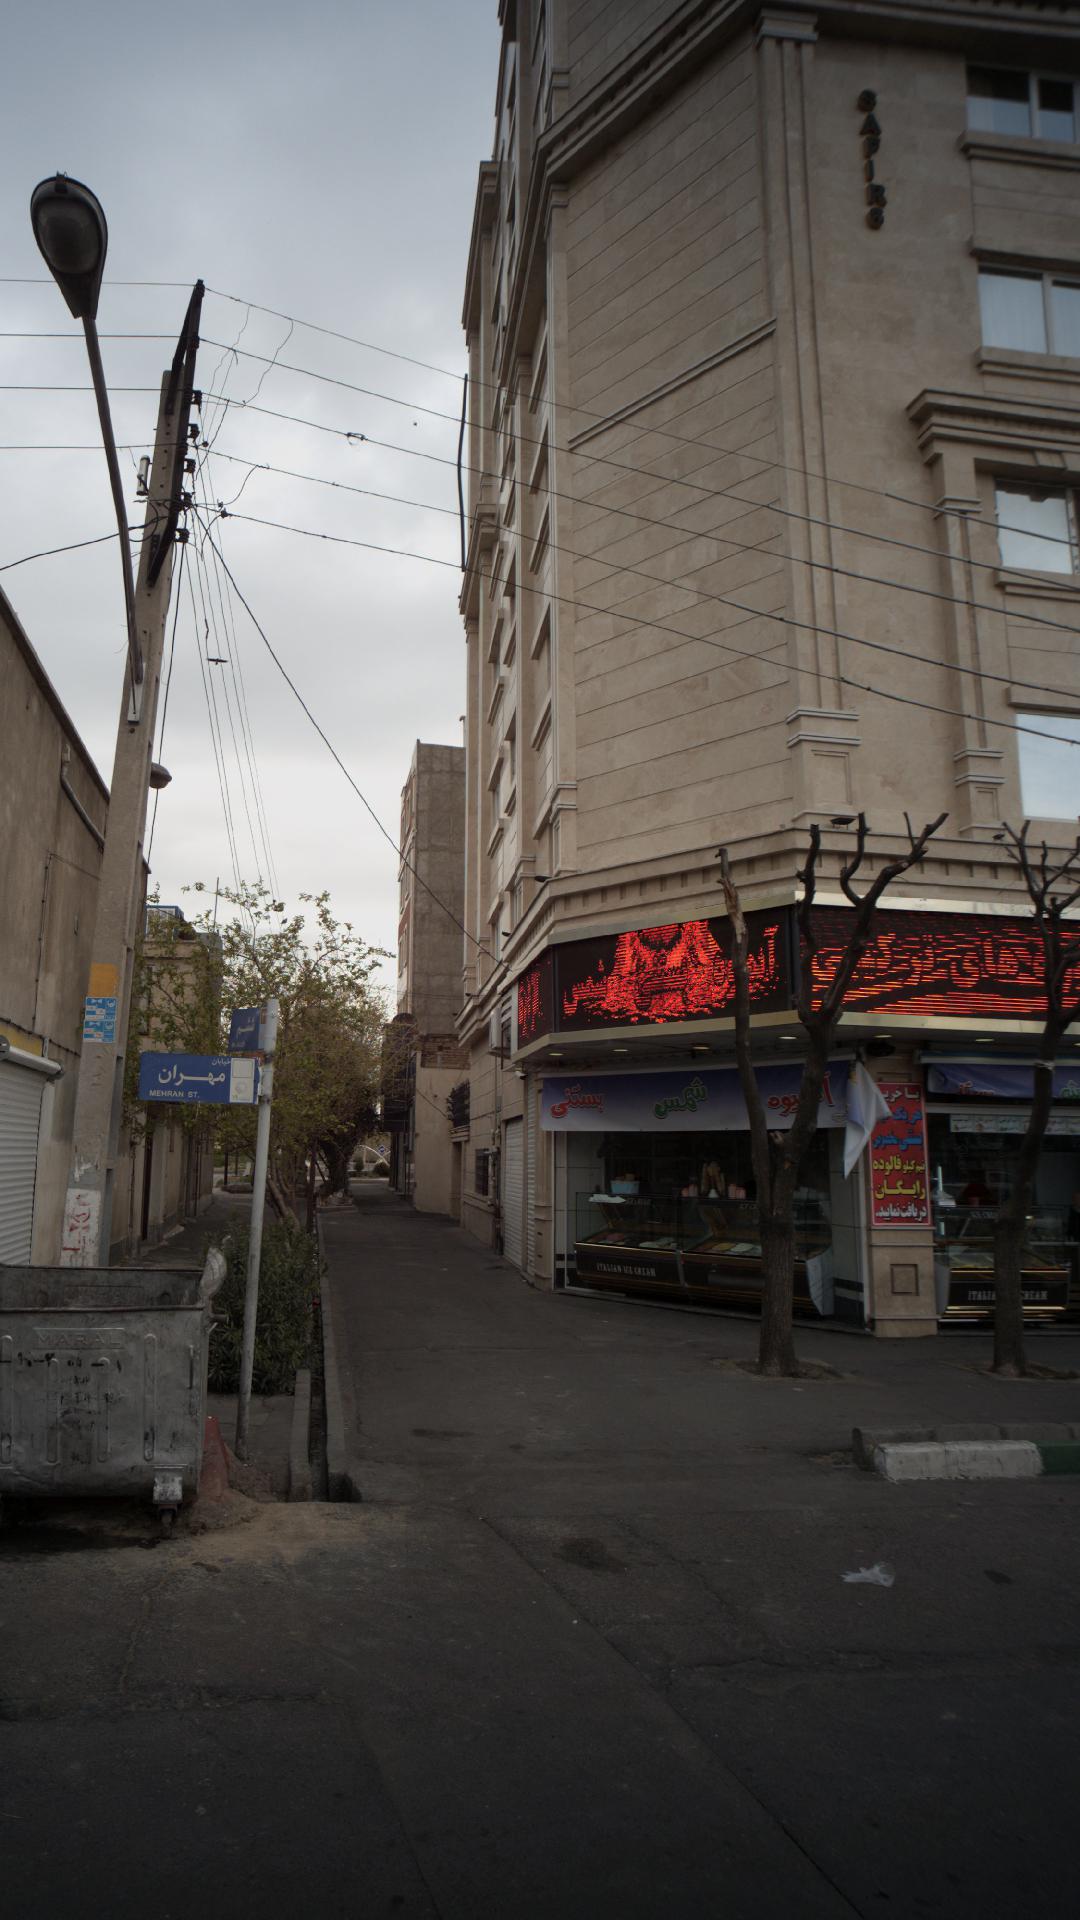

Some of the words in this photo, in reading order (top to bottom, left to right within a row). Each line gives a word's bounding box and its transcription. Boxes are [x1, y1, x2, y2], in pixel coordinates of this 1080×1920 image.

[158, 1064, 226, 1086] مهران
[149, 1089, 184, 1098] MEHRAN
[187, 1091, 200, 1099] ST.
[550, 1082, 604, 1119] بستنی
[654, 1075, 708, 1119] شمس
[882, 1087, 903, 1102] خری
[873, 1154, 902, 1176] فالوده
[596, 1262, 621, 1273] ITALIAN
[634, 1266, 657, 1277] CREAM
[37, 1330, 121, 1347] MARAL
